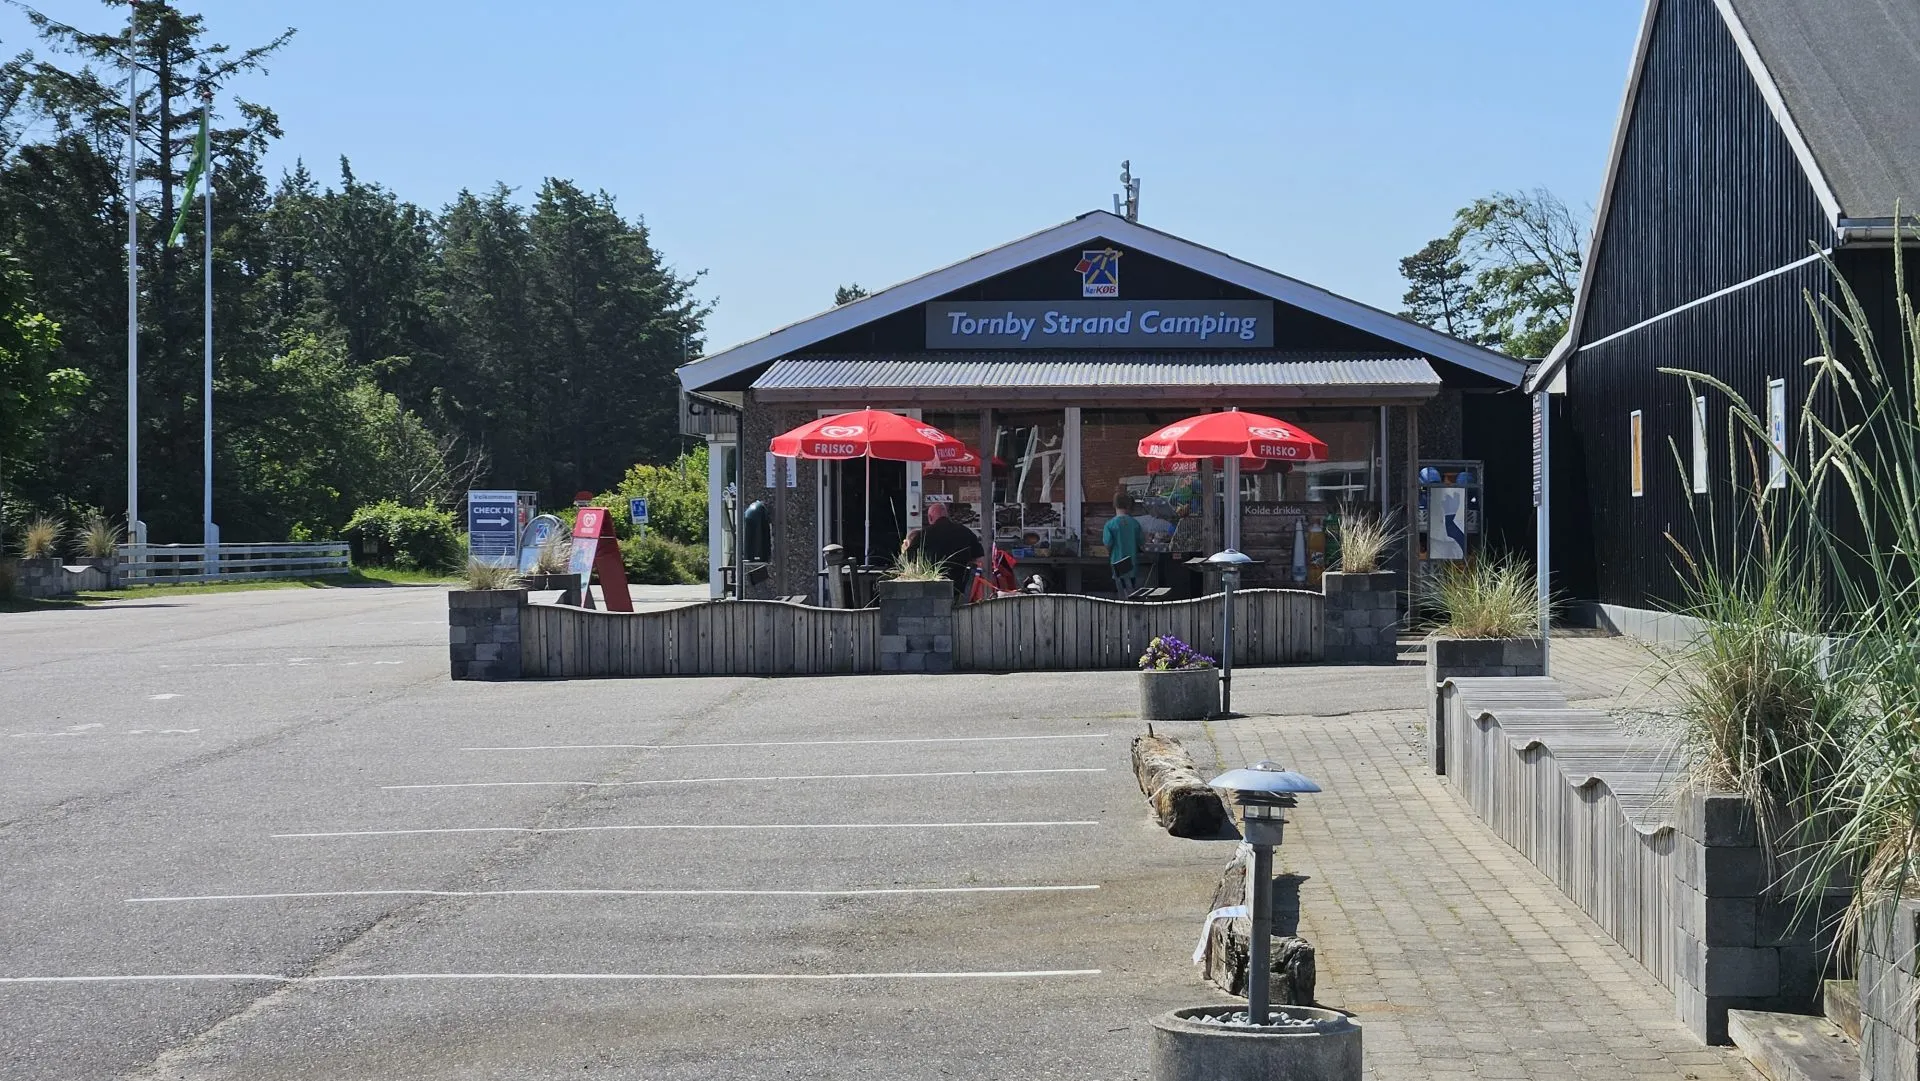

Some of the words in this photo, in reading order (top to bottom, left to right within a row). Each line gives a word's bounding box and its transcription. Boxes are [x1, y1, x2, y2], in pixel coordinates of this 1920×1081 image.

[947, 311, 1036, 341] Tornby
[1042, 310, 1132, 335] Strand
[1139, 310, 1257, 341] Camping
[815, 443, 854, 454] FRISKO
[1260, 444, 1297, 457] FRISKO
[473, 506, 501, 514] CHECK
[503, 506, 514, 514] IN
[1244, 505, 1271, 515] Kolde
[1273, 505, 1301, 515] drikke
